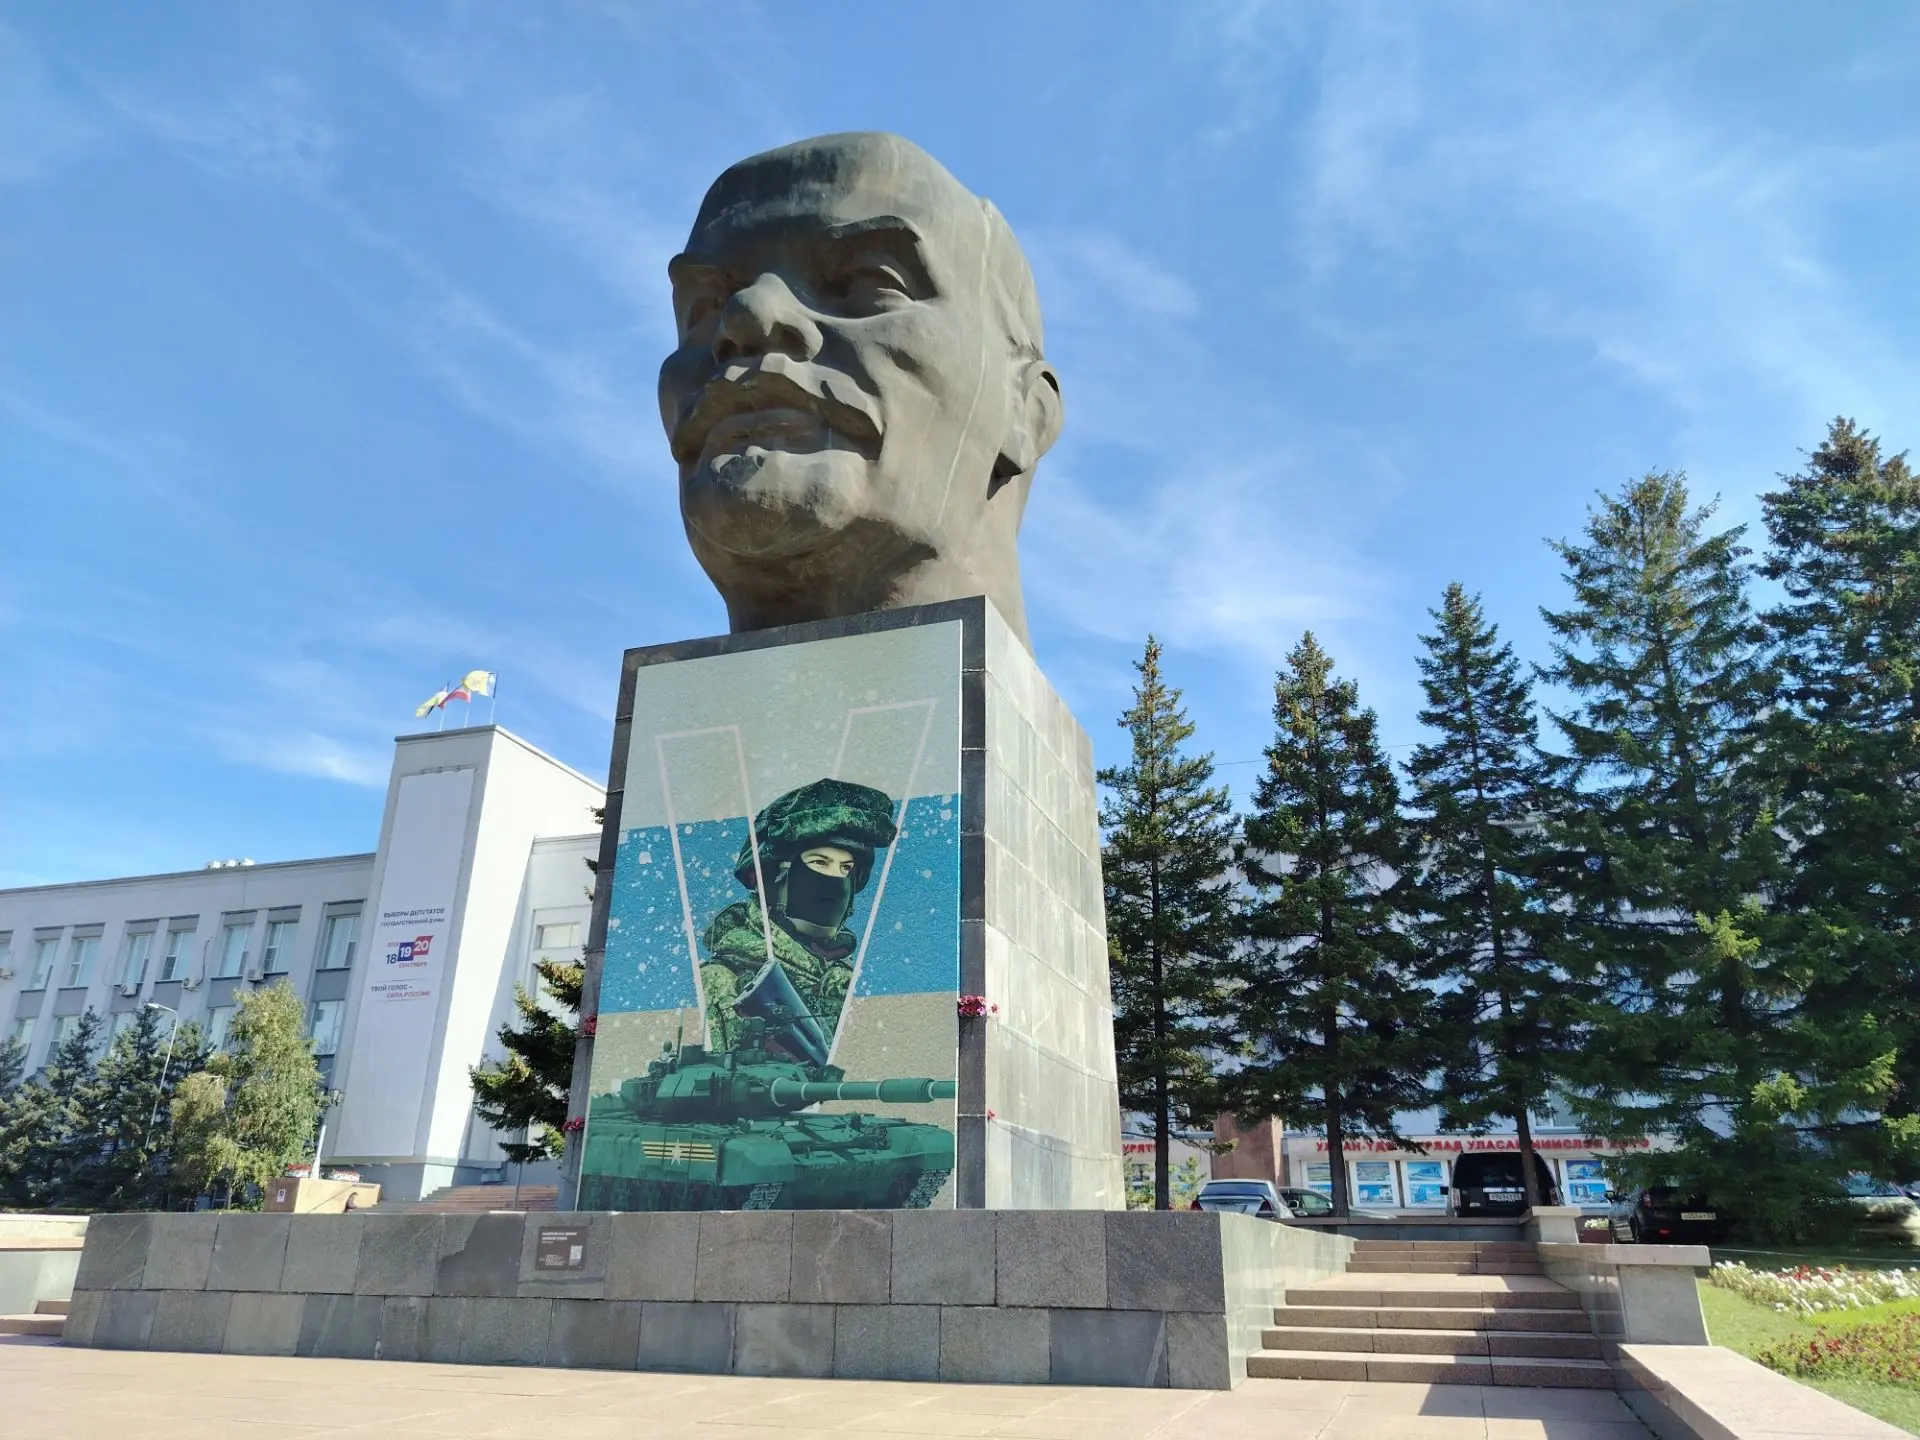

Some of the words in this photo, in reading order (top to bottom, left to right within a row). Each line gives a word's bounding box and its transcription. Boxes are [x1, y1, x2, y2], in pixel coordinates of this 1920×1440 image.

[410, 908, 444, 916] ДЕПУТАТОВ
[386, 953, 397, 965] 18
[400, 946, 412, 958] 19
[414, 940, 429, 951] 20
[371, 984, 387, 992] ТВОЙ
